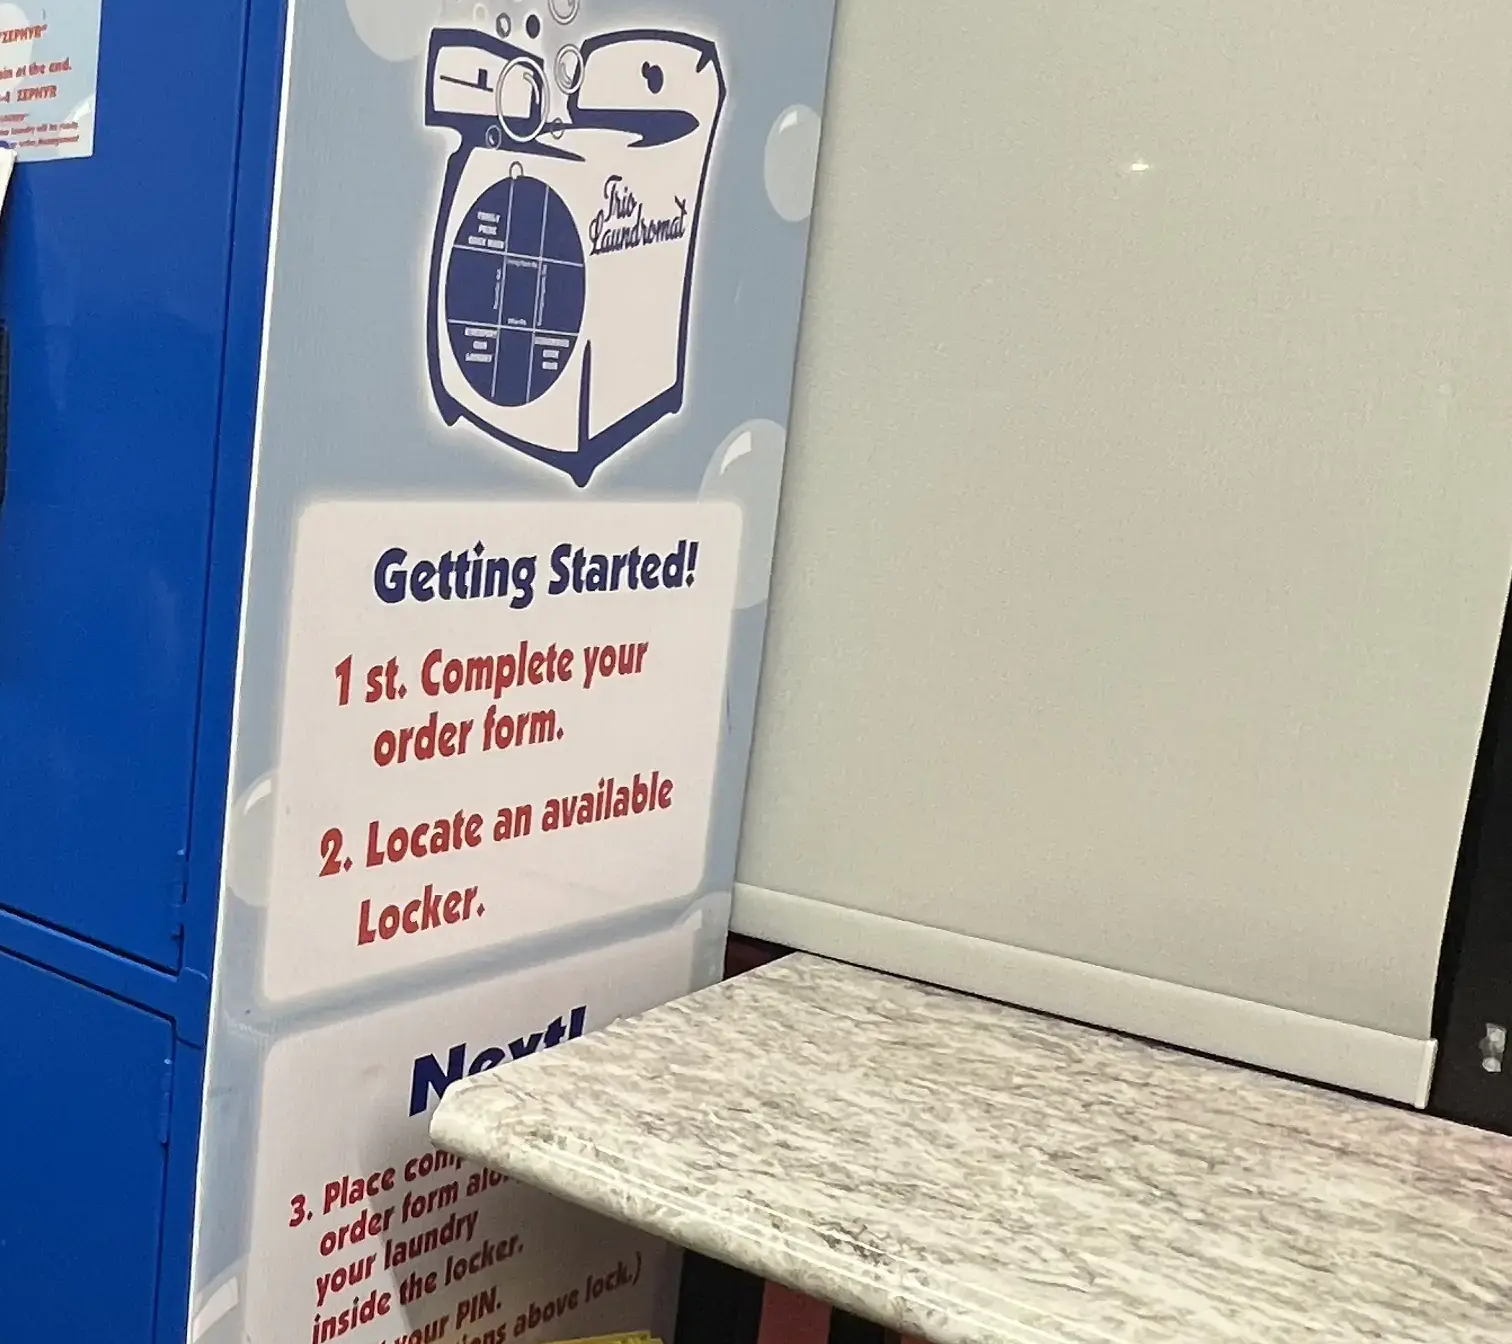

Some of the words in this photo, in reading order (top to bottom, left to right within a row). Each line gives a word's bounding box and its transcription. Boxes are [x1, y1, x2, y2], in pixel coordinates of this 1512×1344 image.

[589, 195, 687, 256] Laundromat
[604, 175, 637, 222] Trio
[373, 540, 537, 610] Getting
[548, 539, 699, 595] Started!
[334, 654, 353, 706] 1
[365, 656, 408, 704] st.
[421, 640, 575, 699] Complete
[582, 640, 649, 689] your
[373, 712, 474, 767] order
[482, 704, 564, 753] form.
[319, 827, 353, 877] 2.
[365, 808, 483, 868] Locate
[493, 800, 533, 843] an
[541, 770, 674, 831] available
[357, 883, 486, 946] Locker.
[288, 1193, 313, 1227] 3.
[323, 1165, 396, 1215] Place
[319, 1206, 395, 1256] order
[402, 1180, 459, 1224] form
[466, 1167, 522, 1197] alo
[315, 1252, 377, 1307] your
[385, 1210, 479, 1271] laundry
[399, 1270, 438, 1306] the
[444, 1233, 524, 1286] locker.
[455, 1285, 501, 1330] PIN.
[513, 1288, 579, 1336] above
[584, 1255, 643, 1303] lock.)
